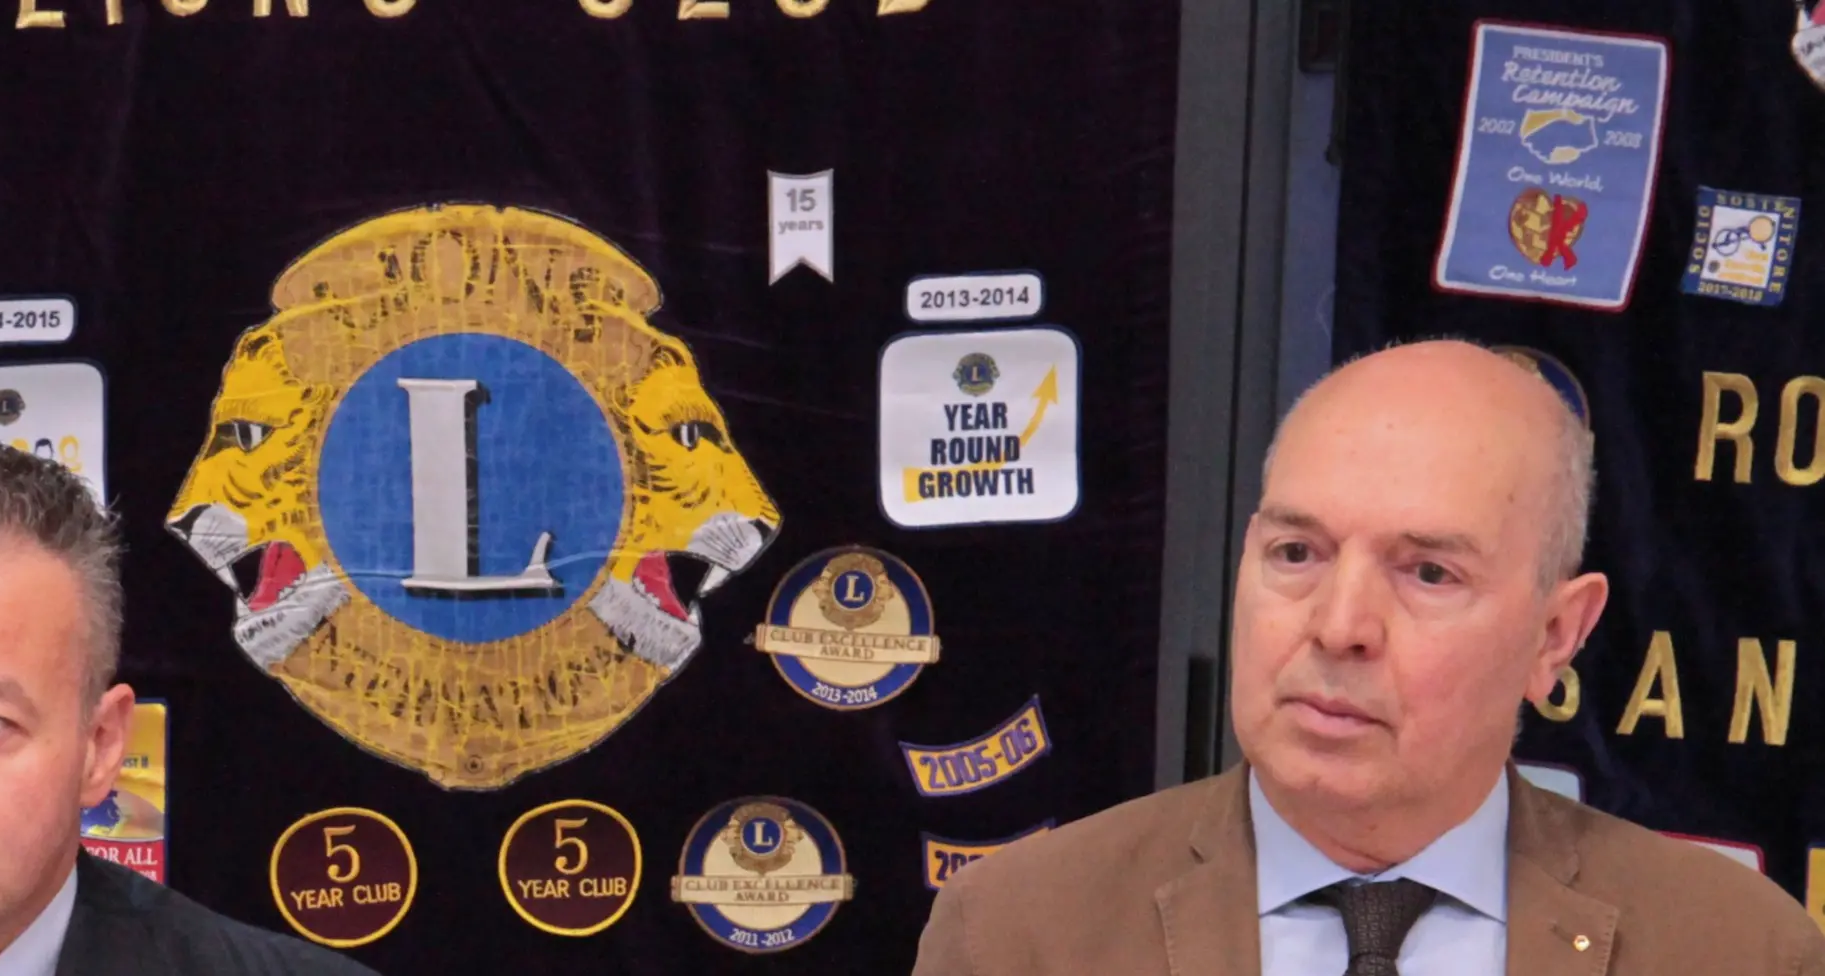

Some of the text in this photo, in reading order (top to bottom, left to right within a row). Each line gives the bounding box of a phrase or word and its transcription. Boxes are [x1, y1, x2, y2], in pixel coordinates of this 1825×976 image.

[1501, 61, 1622, 93] Retention
[1513, 84, 1640, 123] Campaign
[1507, 166, 1542, 184] One
[785, 188, 817, 213] 15
[778, 216, 825, 234] years
[920, 286, 1030, 309] 2013-2014
[944, 402, 1008, 430] YEAR
[930, 434, 1021, 467] ROUND
[397, 377, 565, 592] L
[918, 468, 1035, 499] GROWTH
[770, 629, 927, 652] CLUB EXCELLENCE
[819, 645, 875, 660] AWARD
[811, 682, 878, 704] 2013-2014
[919, 718, 1038, 790] 2005-06
[123, 847, 159, 865] ALL
[322, 824, 361, 883] 5
[552, 817, 589, 875] 5
[517, 877, 627, 899] YEAR CLUB
[685, 878, 841, 891] CLUB EXCELLENCE
[733, 891, 789, 902] AWARD
[291, 883, 401, 911] YEAR CLUB
[729, 928, 795, 947] 2011-2012
